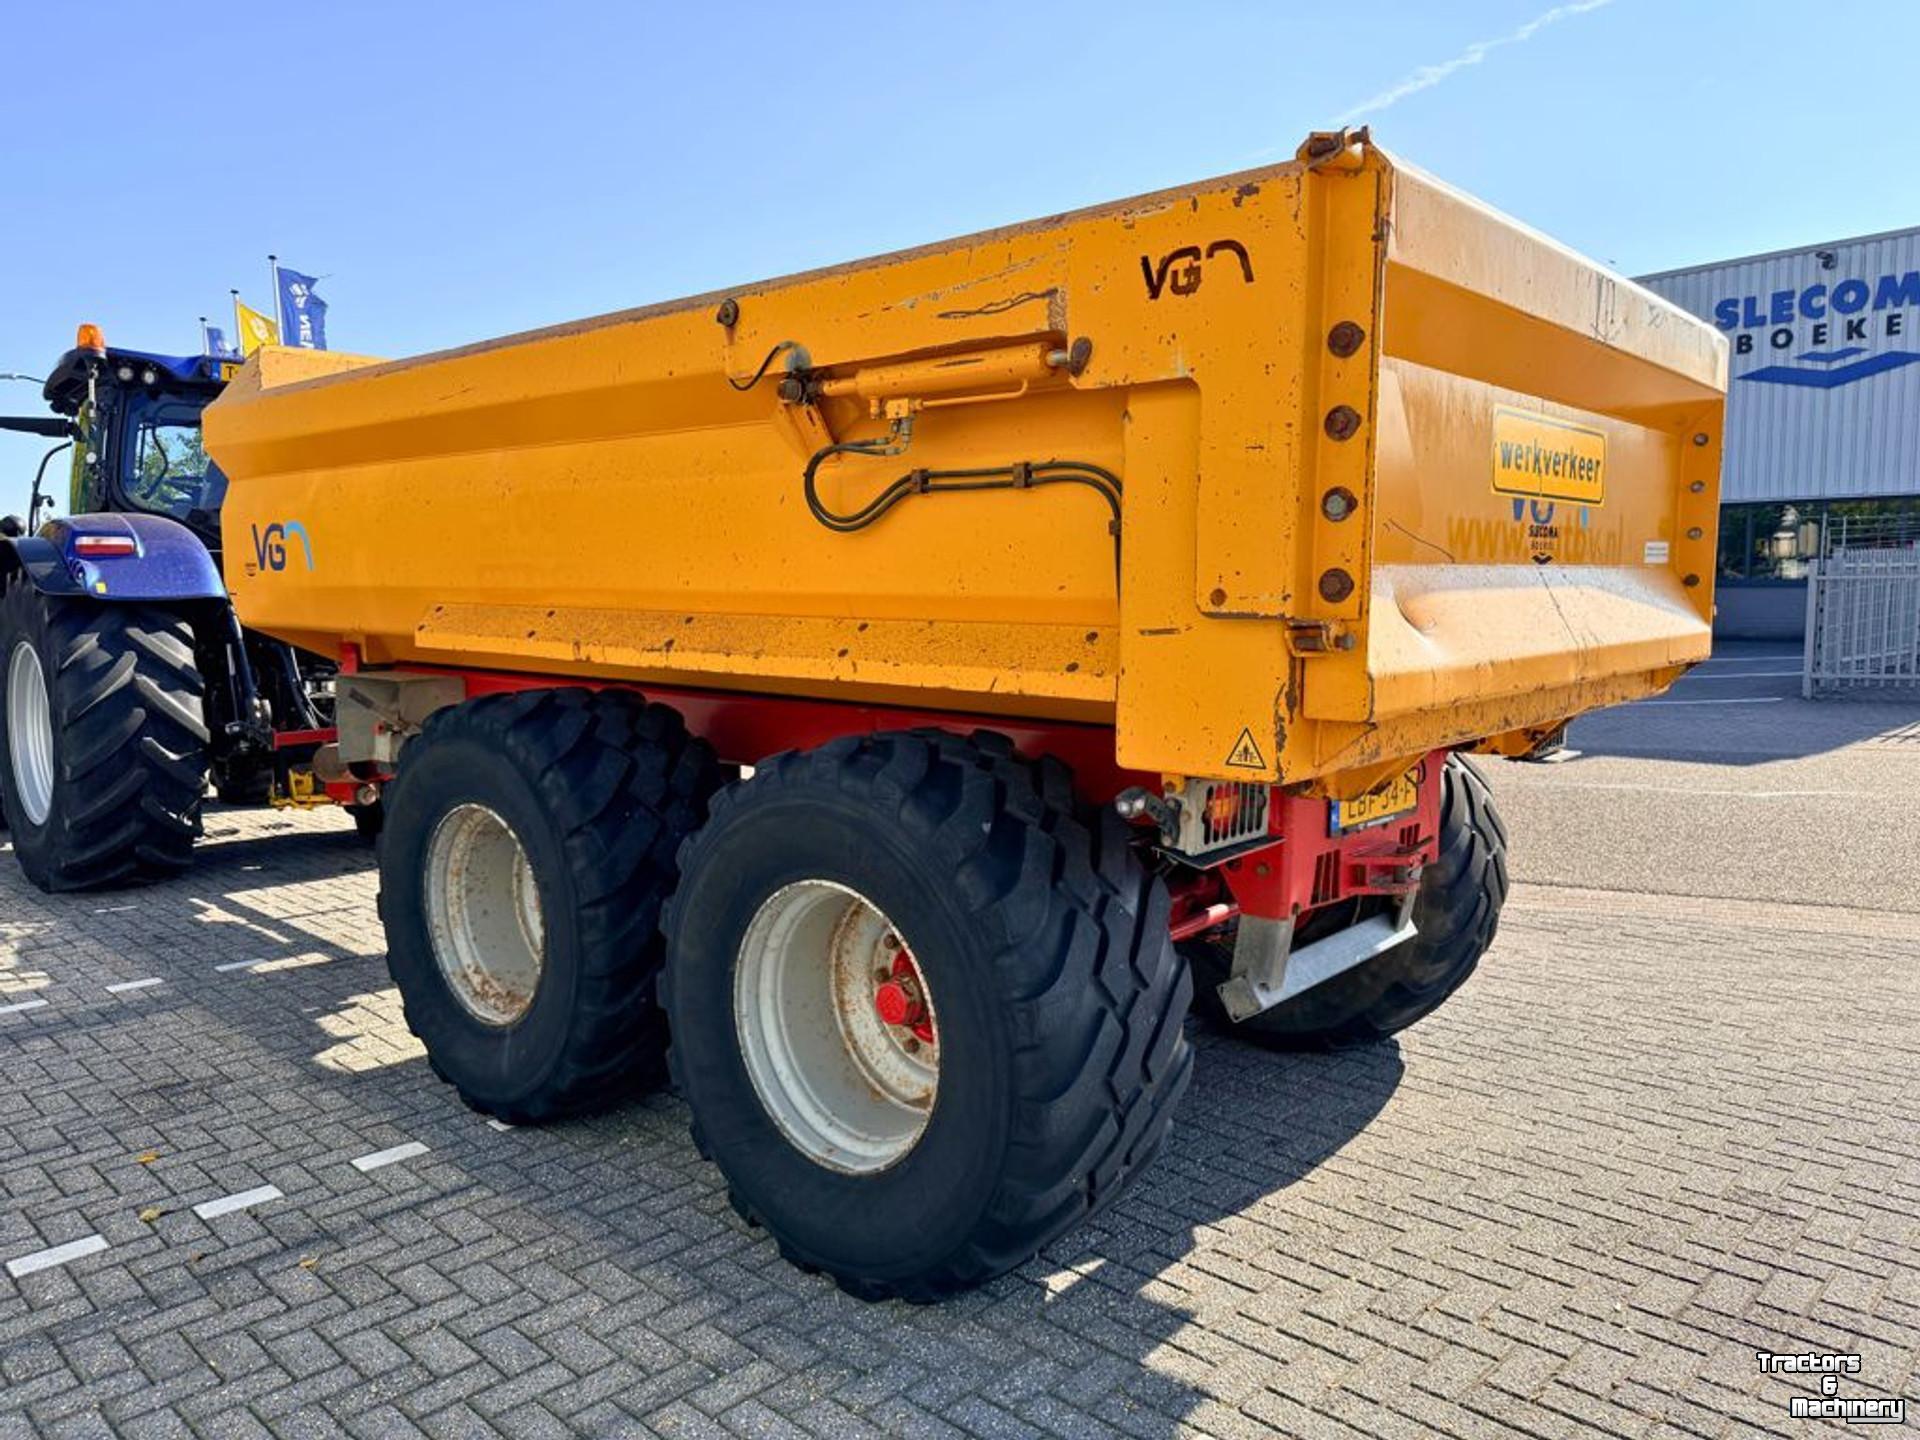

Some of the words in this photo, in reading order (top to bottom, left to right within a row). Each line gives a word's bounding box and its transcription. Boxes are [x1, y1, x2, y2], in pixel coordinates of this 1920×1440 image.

[1715, 271, 1920, 331] SLECOM
[1736, 313, 1903, 355] BOEKE
[1500, 438, 1601, 484] werkverkeer
